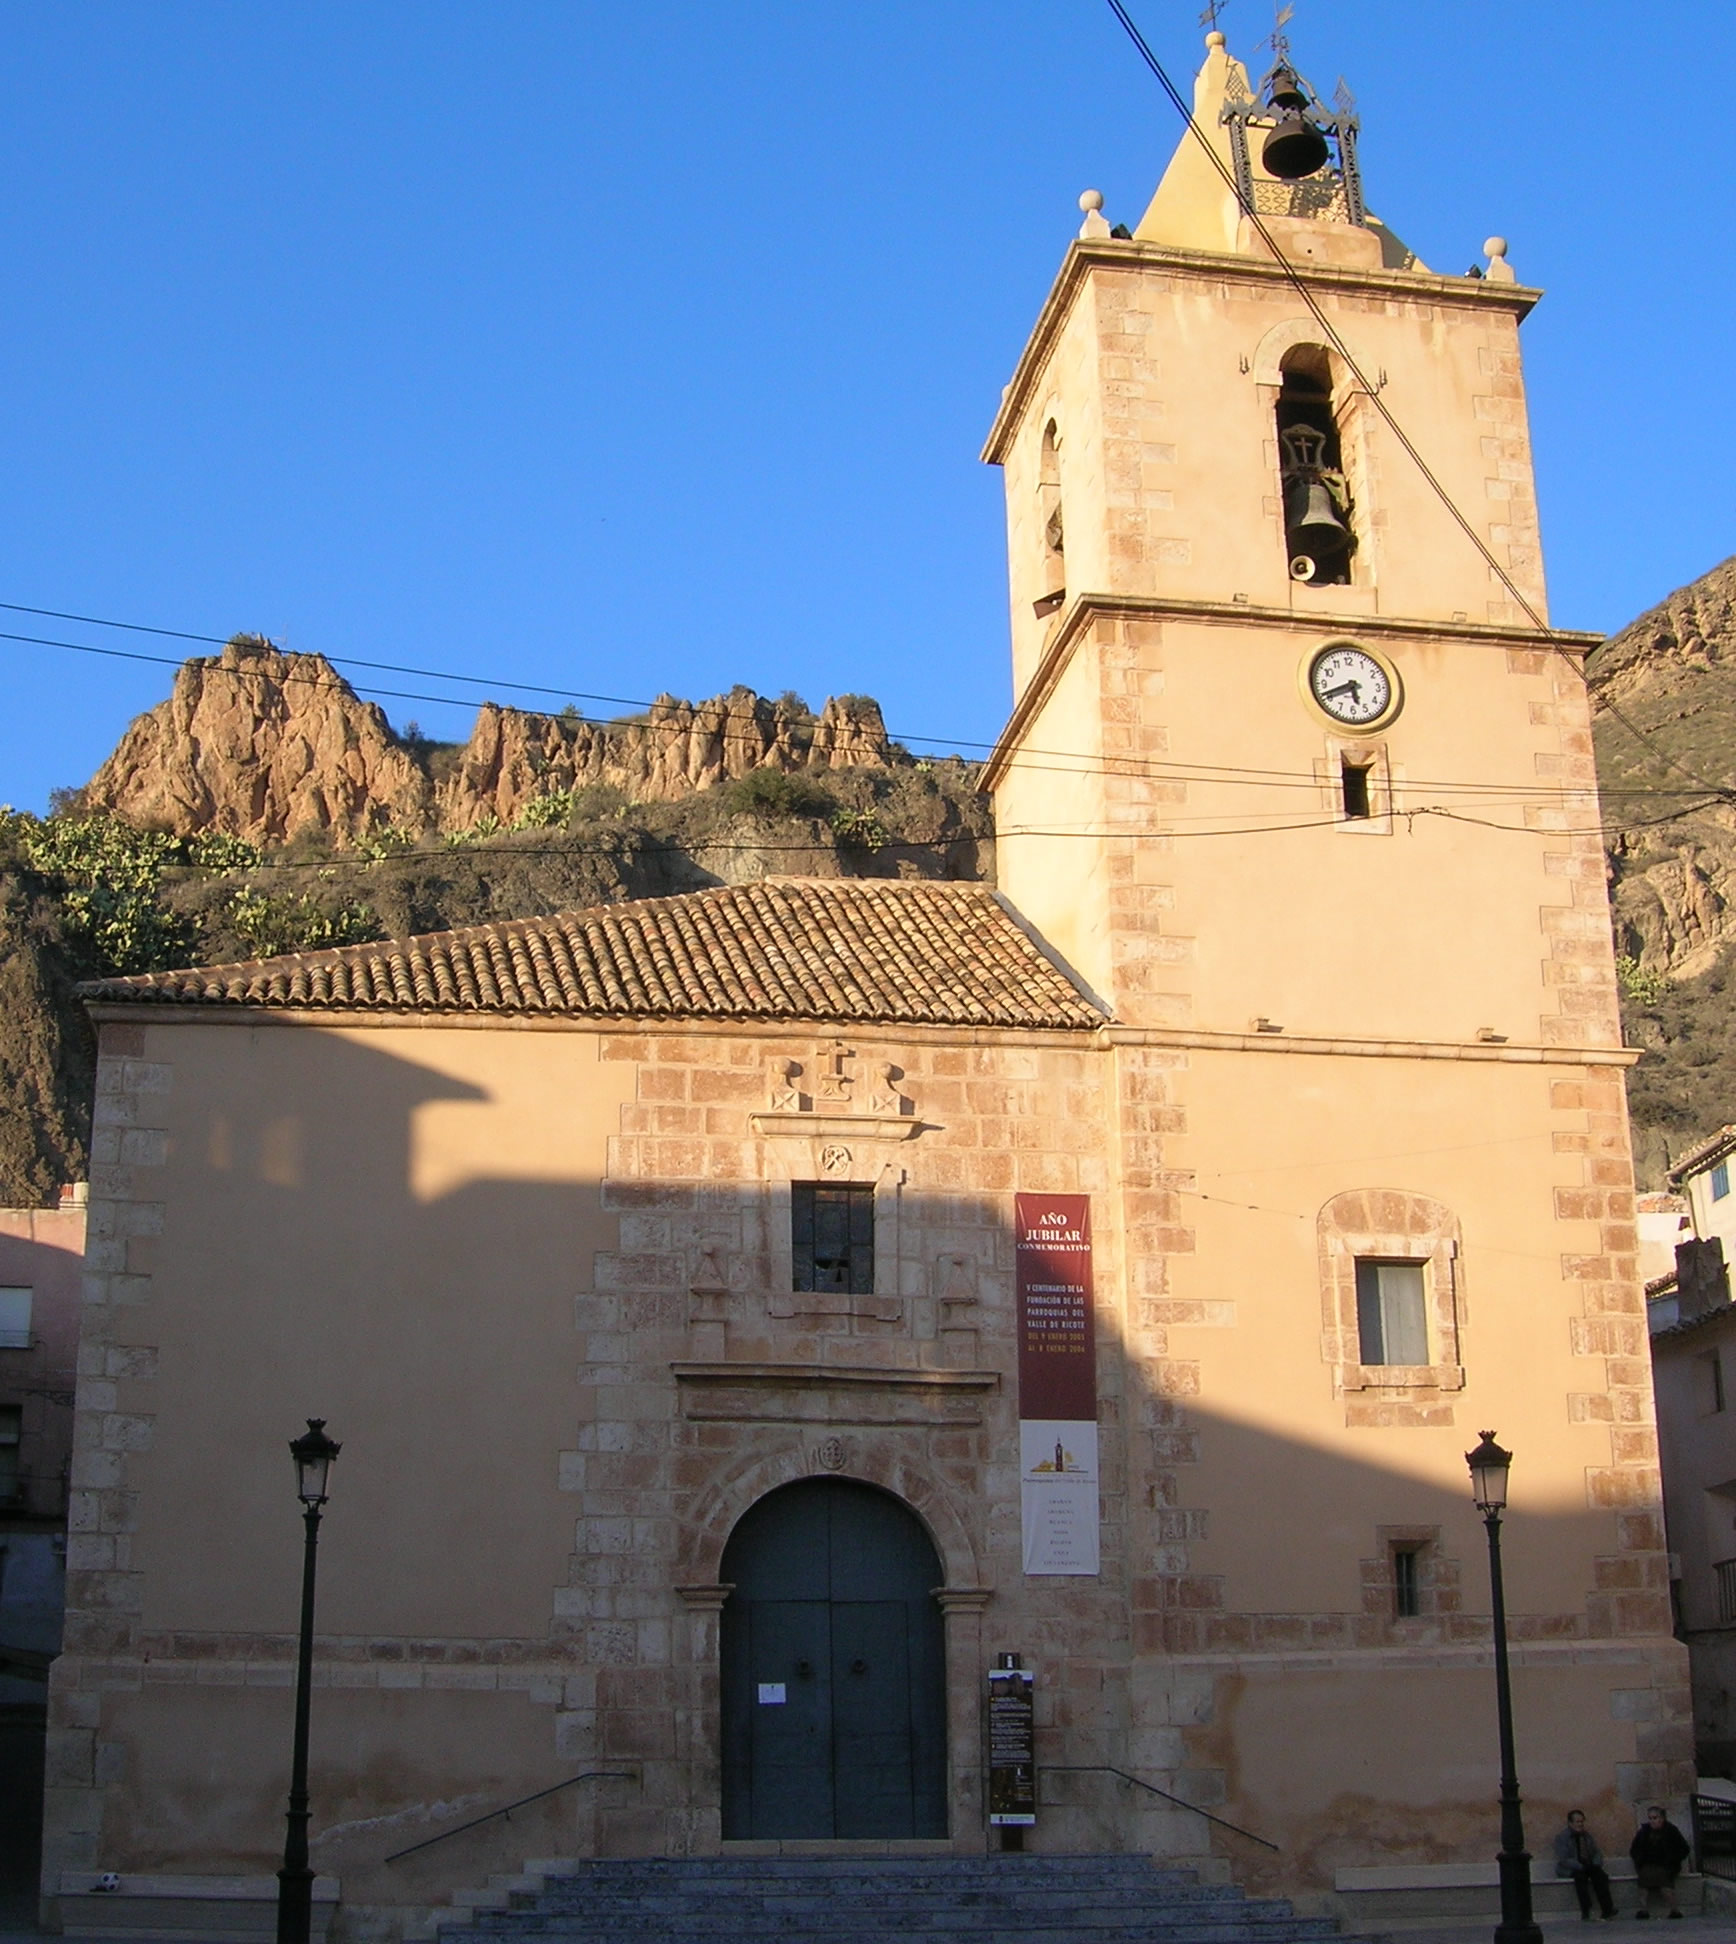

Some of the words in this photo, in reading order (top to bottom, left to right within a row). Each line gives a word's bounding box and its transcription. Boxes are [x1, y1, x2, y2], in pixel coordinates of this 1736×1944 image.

[1333, 660, 1340, 668] 11
[1344, 656, 1353, 666] 12
[1360, 661, 1364, 669] 1
[1324, 668, 1334, 677] 10
[1370, 670, 1376, 679] 2
[1321, 680, 1327, 688] 9
[1375, 683, 1381, 692] 3
[1372, 696, 1378, 704] 4
[1338, 702, 1343, 711] 7
[1350, 706, 1356, 715] 6
[1362, 704, 1368, 713] 5
[1039, 1212, 1067, 1225] AÑO
[1025, 1229, 1081, 1241] JUBILAR
[1017, 1243, 1091, 1251] CONMEMORATIVO
[1027, 1308, 1068, 1316] PARROQUIAS
